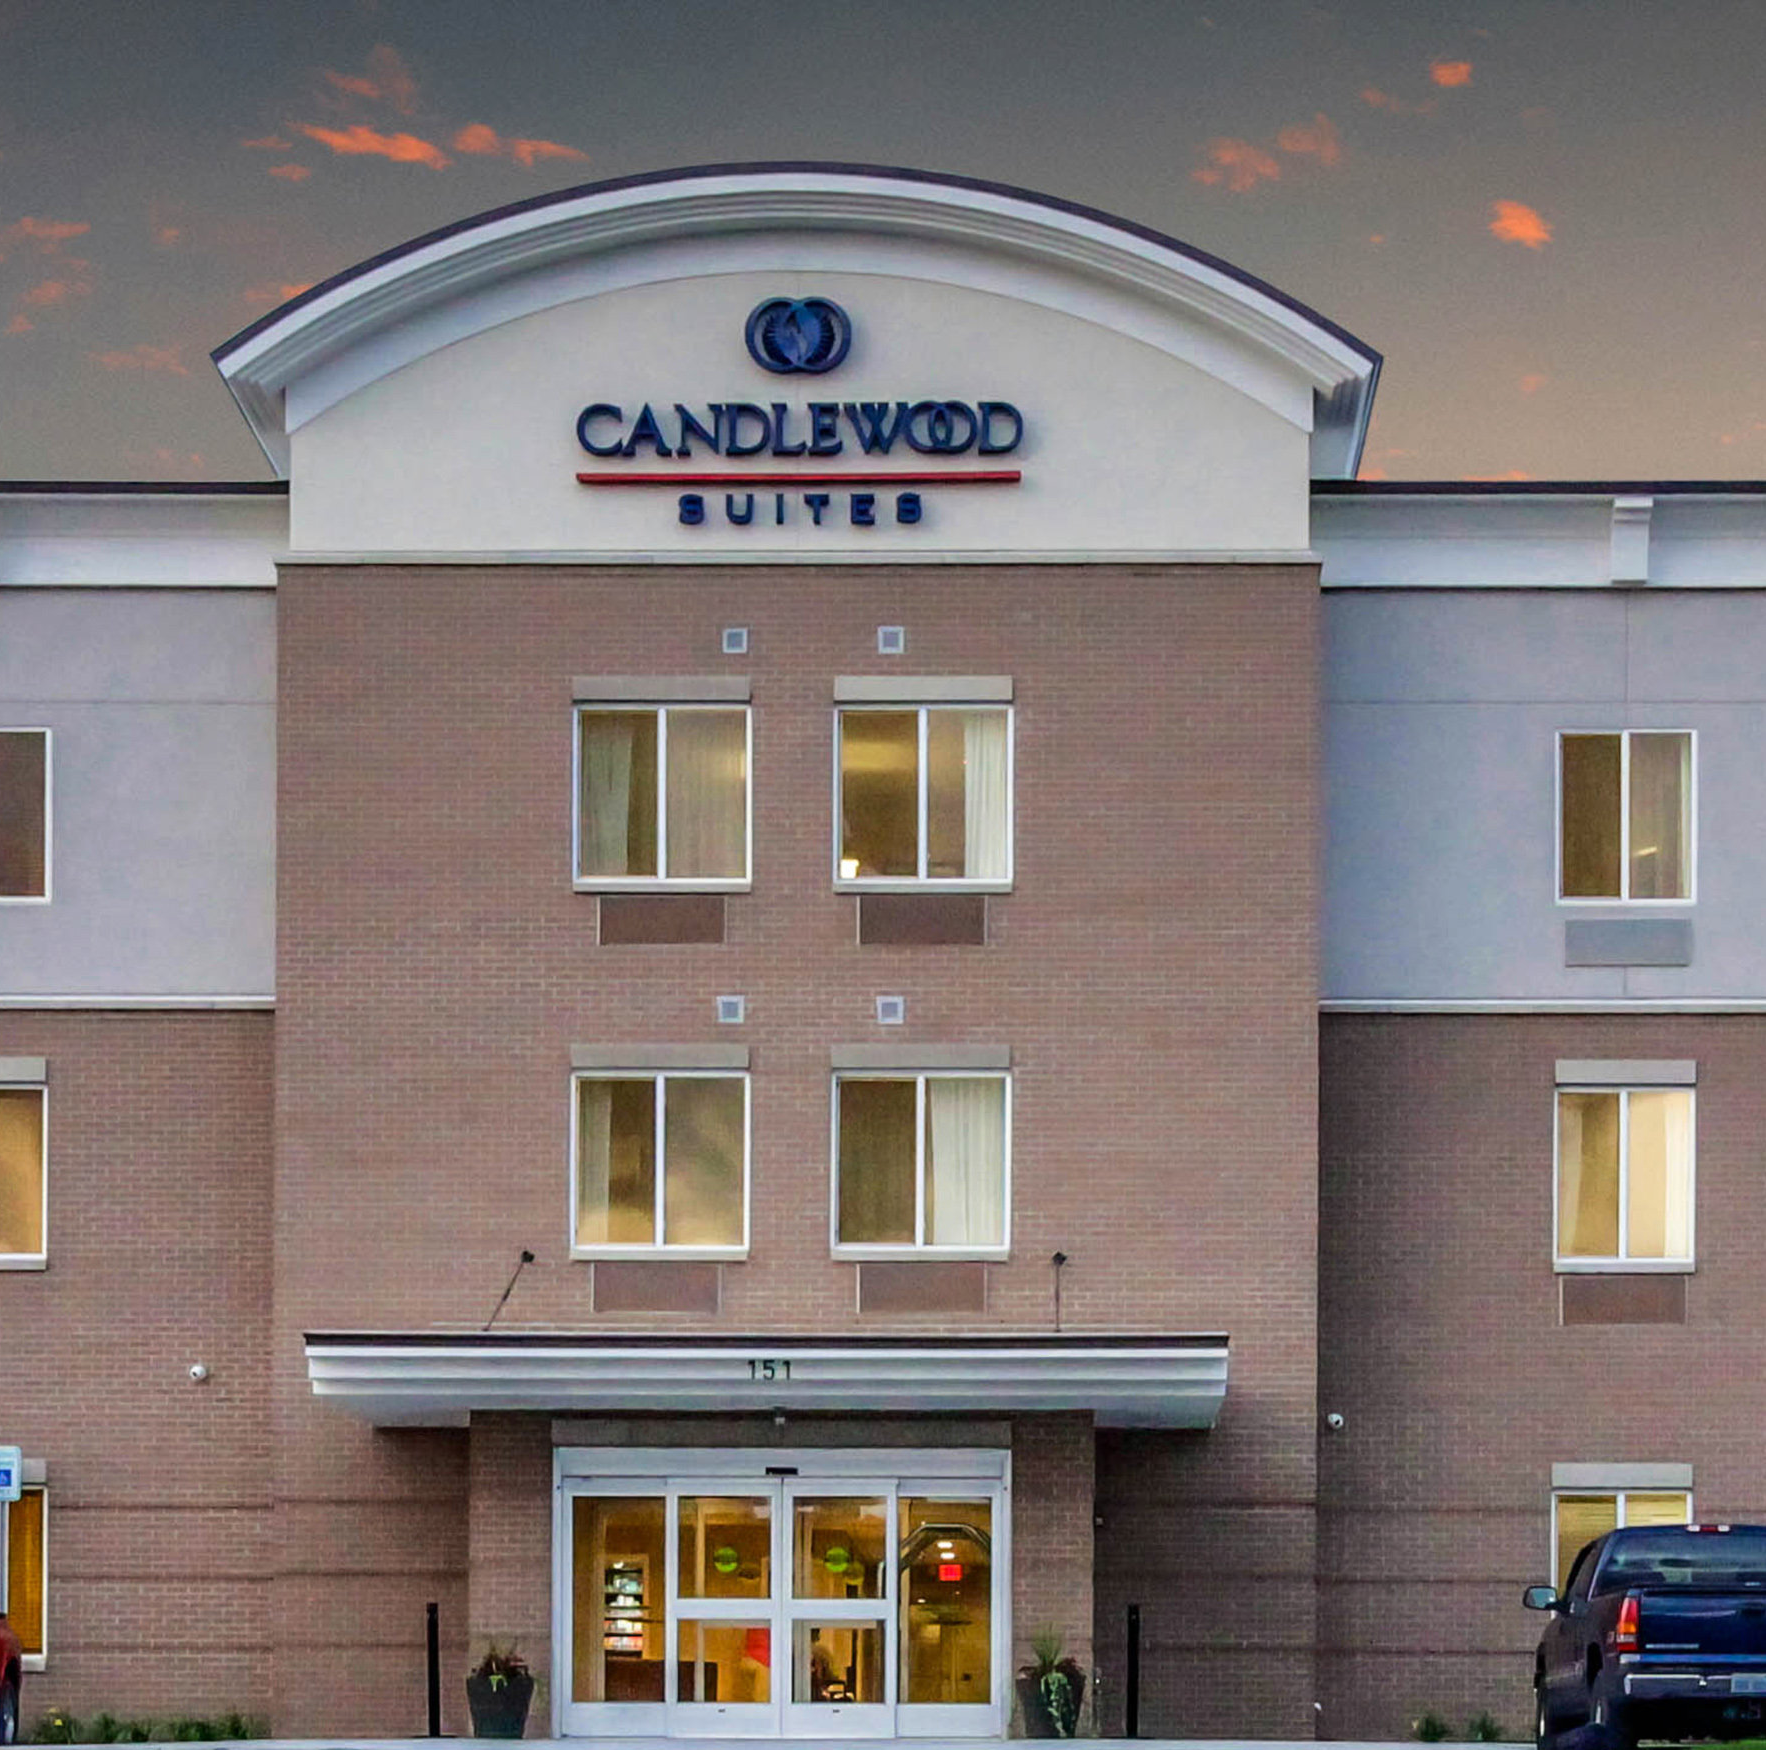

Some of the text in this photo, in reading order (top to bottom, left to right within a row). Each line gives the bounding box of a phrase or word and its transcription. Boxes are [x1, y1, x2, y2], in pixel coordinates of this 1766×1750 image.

[575, 399, 1024, 458] CANDLEWOOD
[678, 492, 923, 526] SUITES
[748, 1359, 791, 1381] 151
